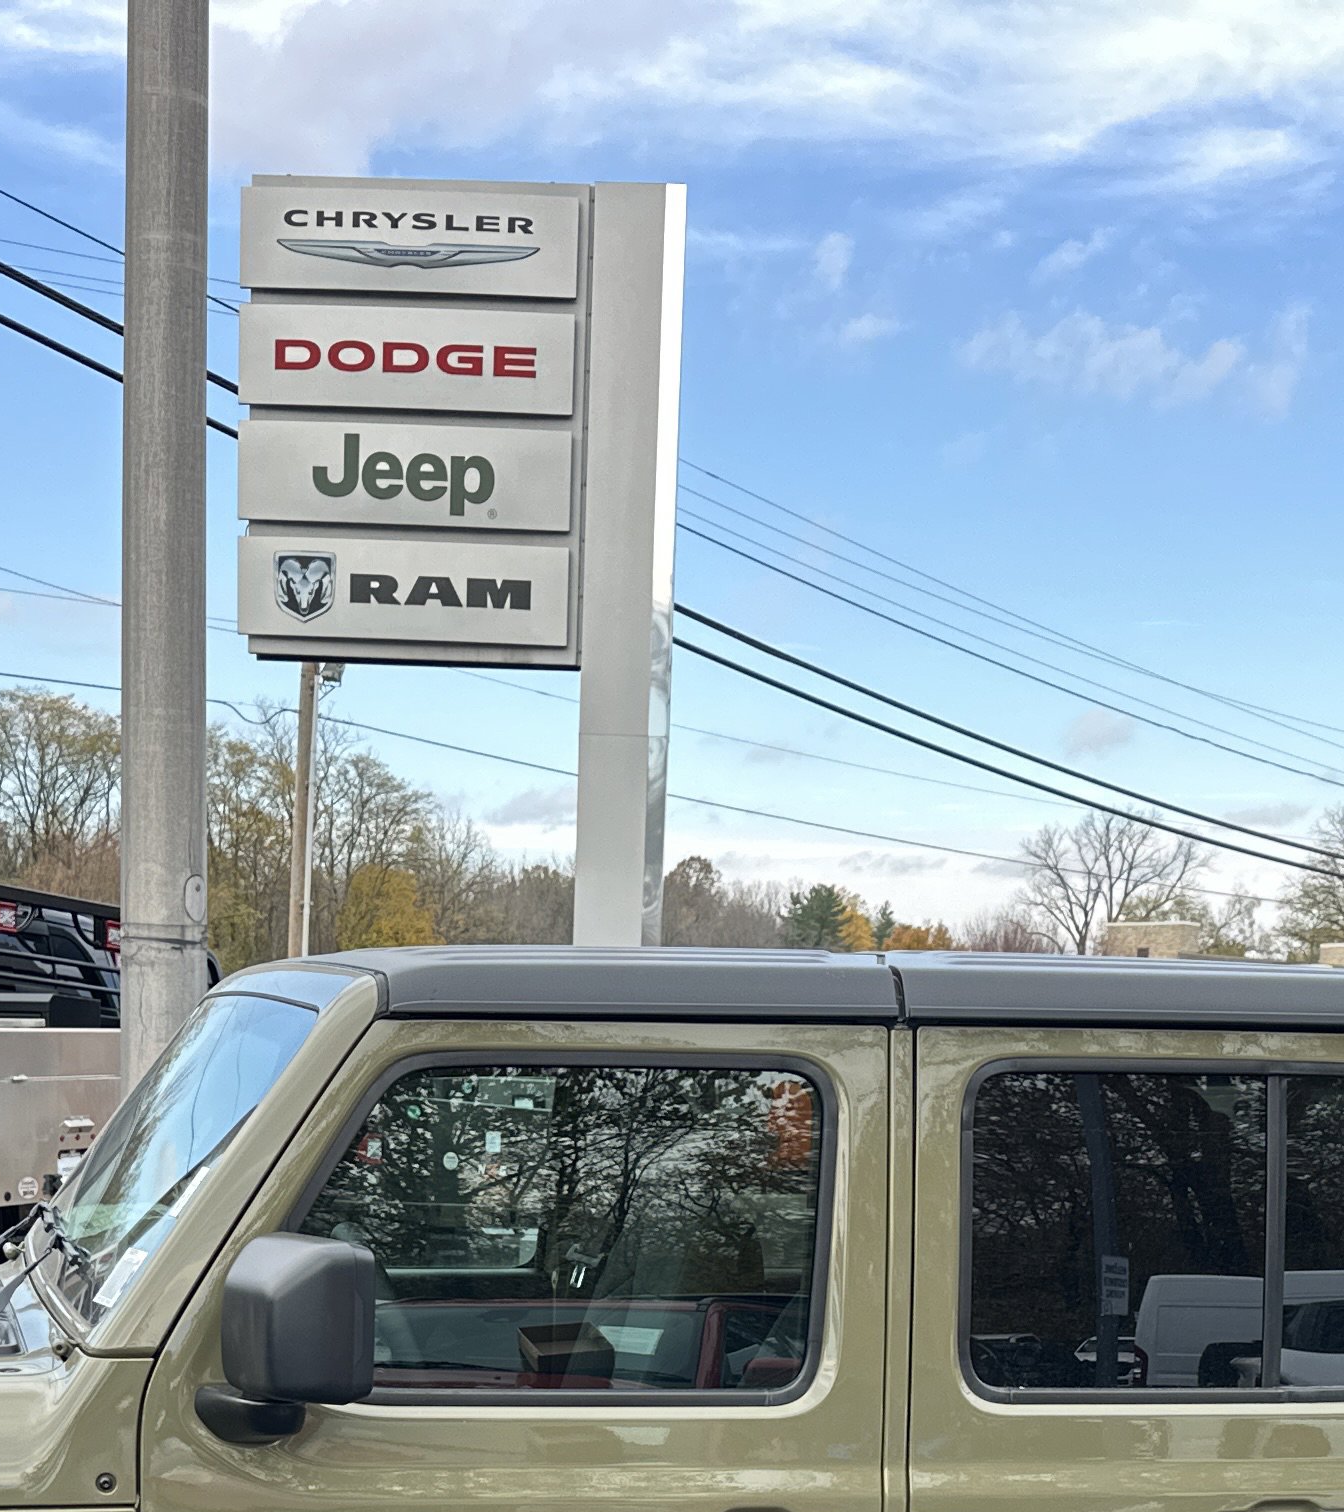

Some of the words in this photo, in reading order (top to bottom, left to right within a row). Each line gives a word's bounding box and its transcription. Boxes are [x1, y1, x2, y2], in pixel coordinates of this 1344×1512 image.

[283, 209, 534, 235] CHRYSLER
[274, 339, 537, 379] DODGE
[312, 433, 495, 516] Jeep
[349, 573, 532, 611] RAM
